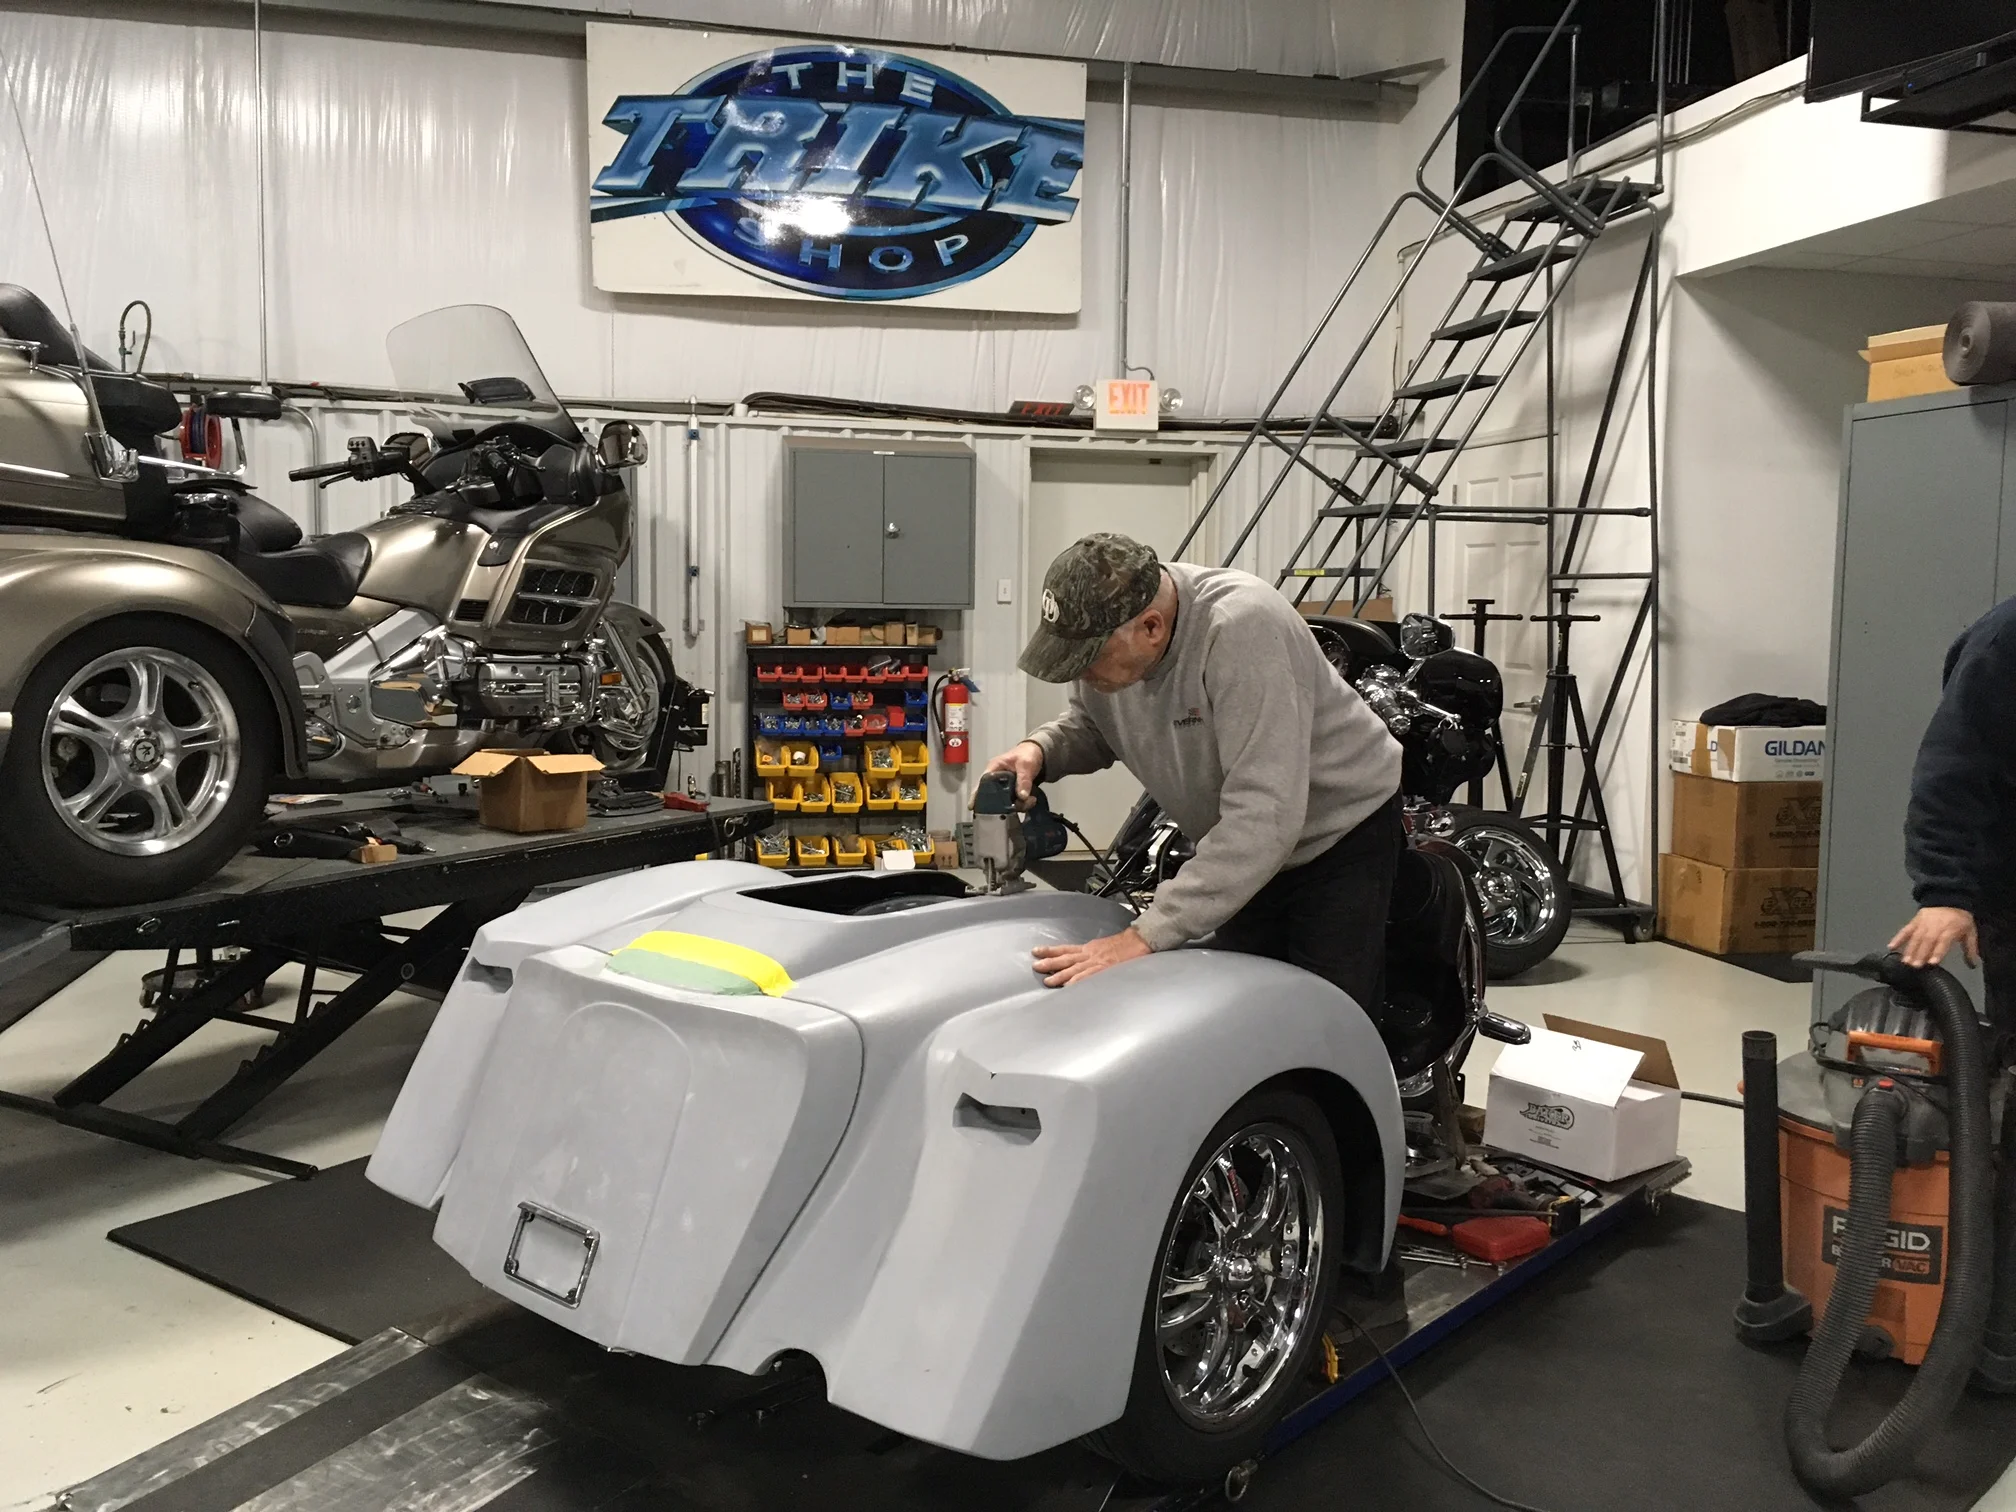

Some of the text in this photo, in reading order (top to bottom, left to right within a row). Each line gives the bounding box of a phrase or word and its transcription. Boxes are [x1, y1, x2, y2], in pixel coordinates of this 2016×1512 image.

[771, 61, 937, 107] THE
[592, 94, 1086, 225] TRIKE
[733, 217, 970, 273] SHOP
[1108, 382, 1150, 414] EXIT
